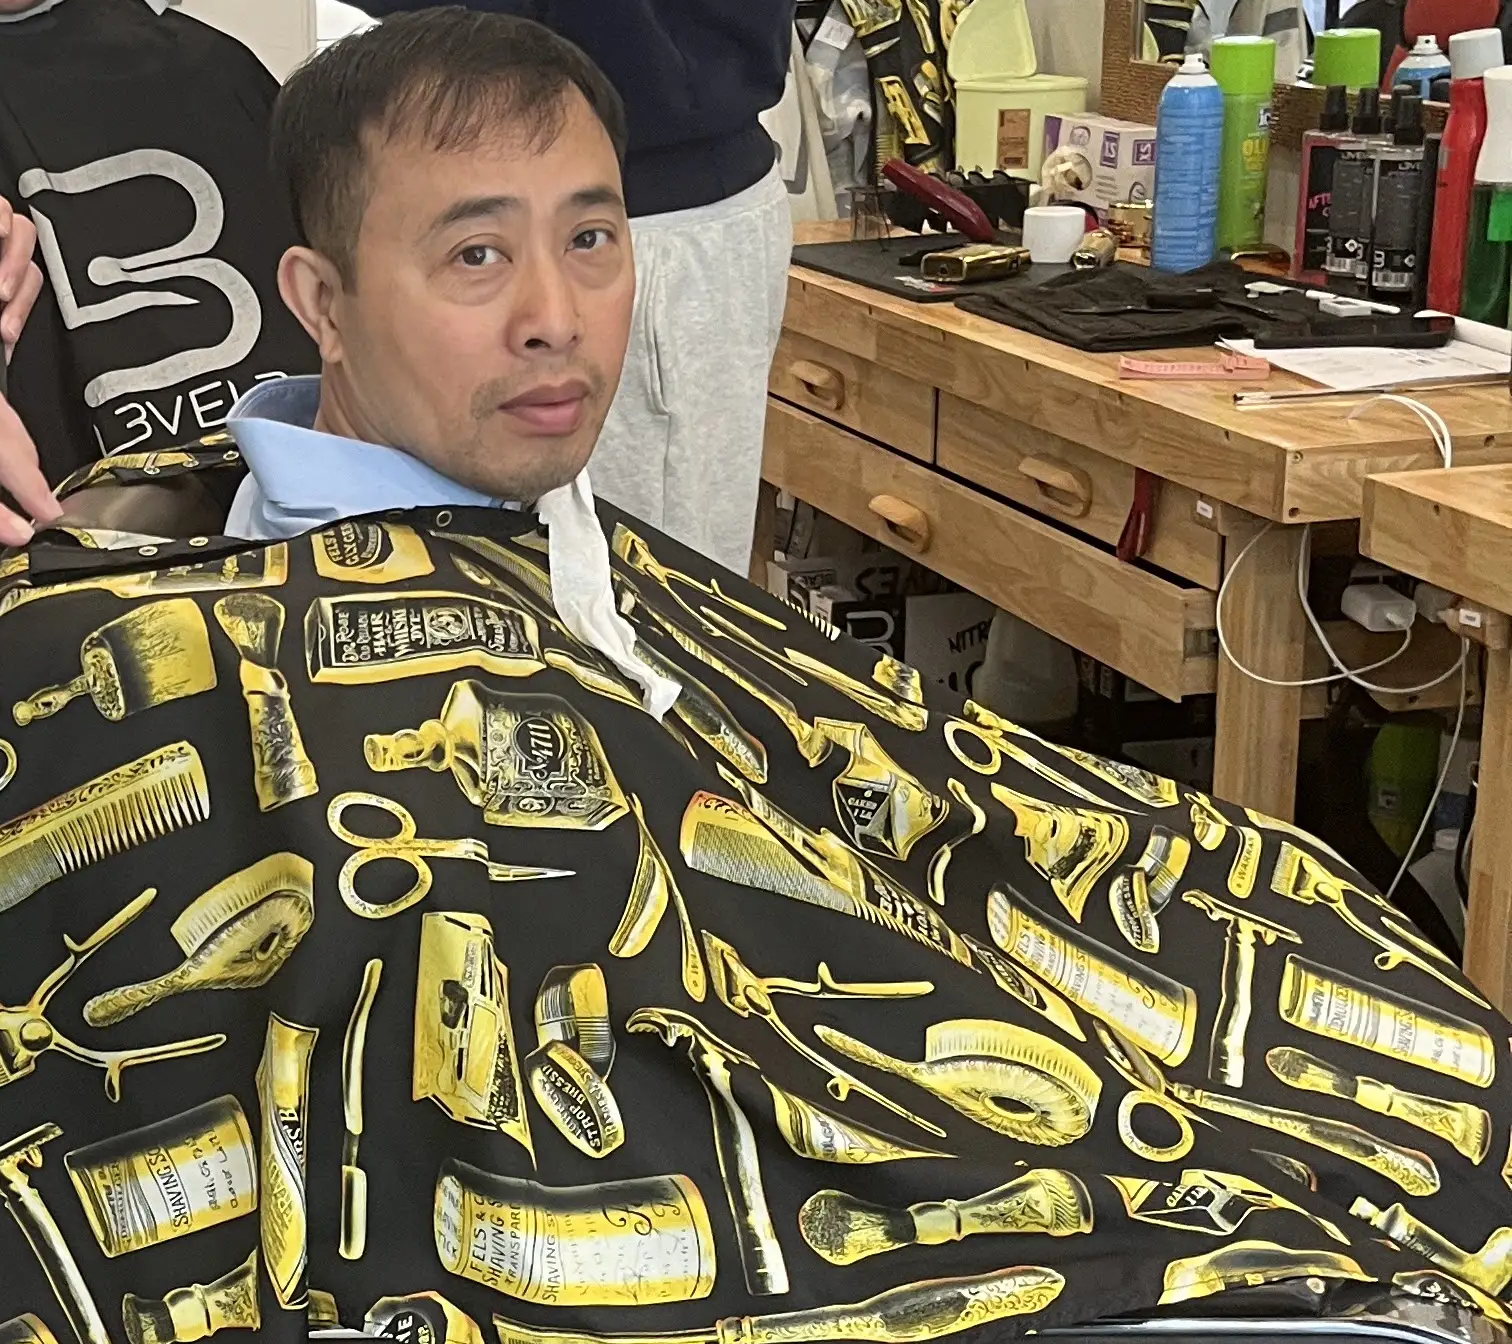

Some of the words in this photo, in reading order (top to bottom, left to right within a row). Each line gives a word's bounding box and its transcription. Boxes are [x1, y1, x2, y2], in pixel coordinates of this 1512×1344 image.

[92, 370, 288, 459] L3VE
[370, 609, 387, 657] HAIR
[409, 607, 425, 646] DYE
[526, 722, 554, 760] 4711
[568, 1104, 601, 1148] STROP
[156, 1165, 190, 1228] SHAVING
[469, 1227, 488, 1273] FELS
[481, 1216, 506, 1287] SHAVING
[542, 1233, 561, 1303] SHAVING
